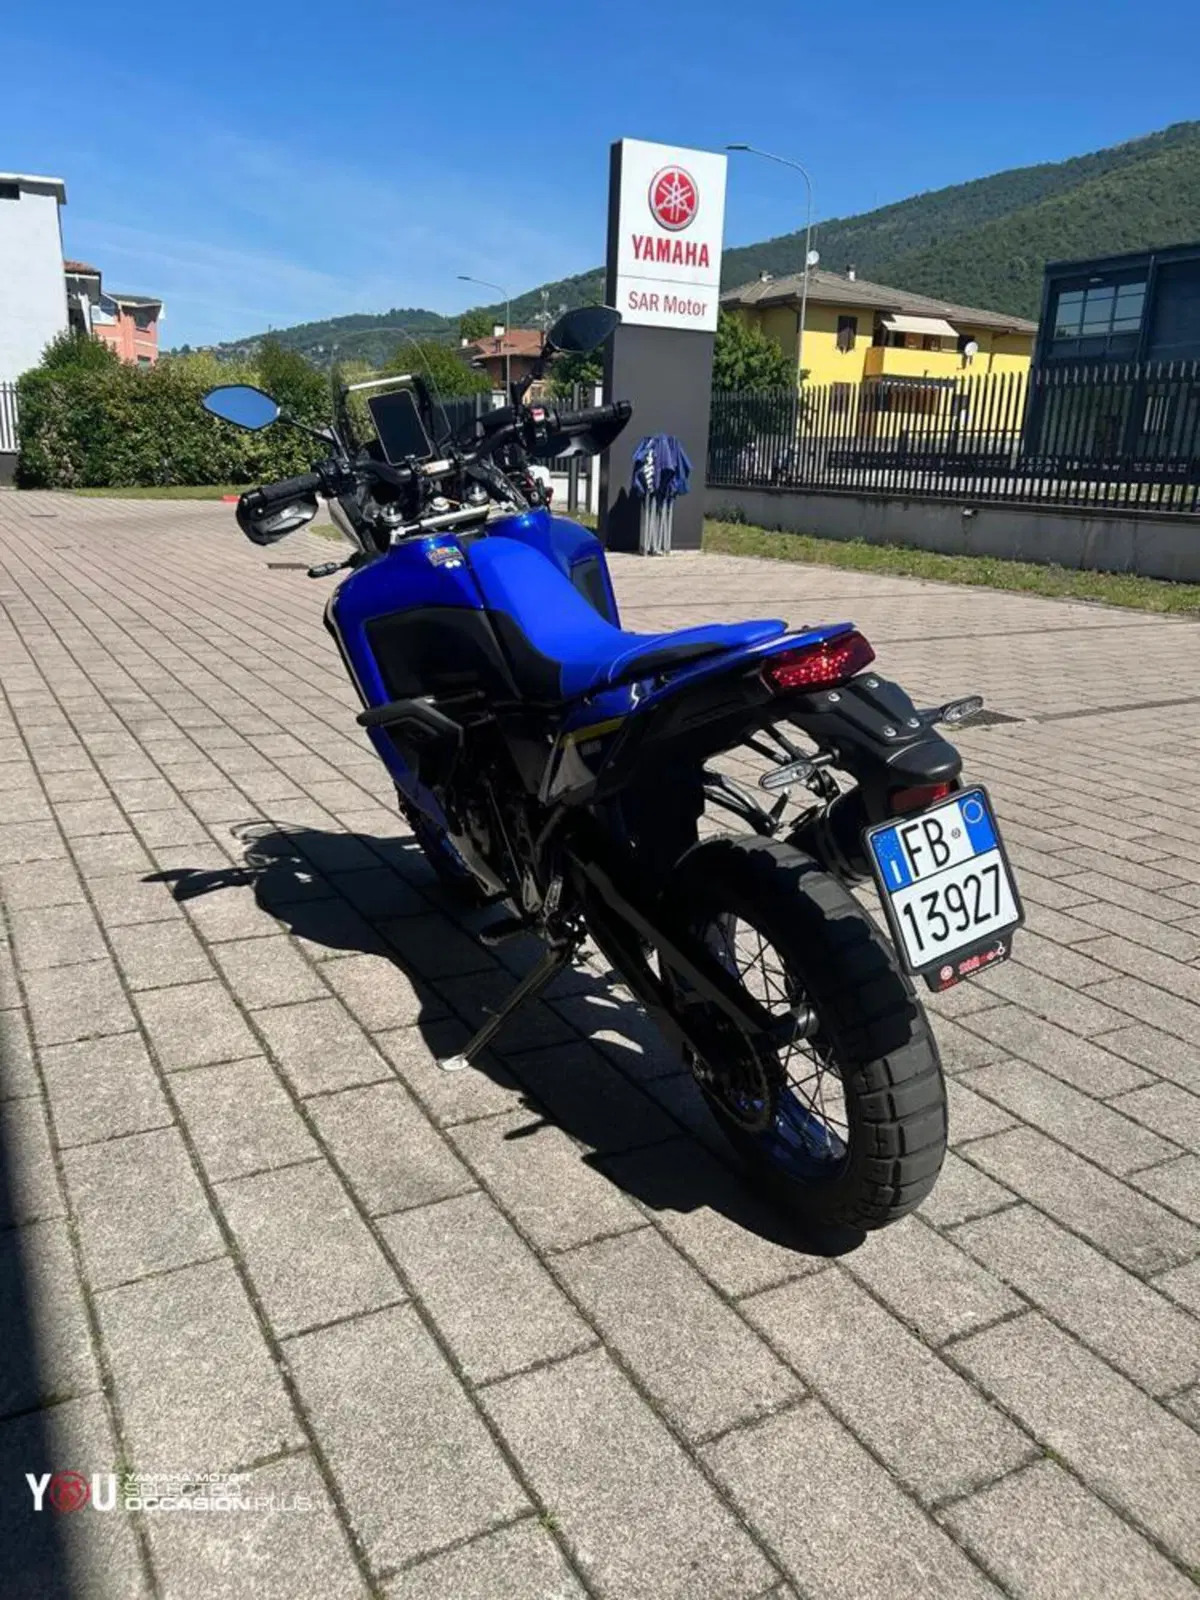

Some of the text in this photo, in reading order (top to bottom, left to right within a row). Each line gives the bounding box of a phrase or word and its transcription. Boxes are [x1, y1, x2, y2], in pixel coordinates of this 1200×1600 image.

[632, 234, 709, 268] YAMAHA
[628, 290, 708, 316] SAR Motor
[900, 817, 950, 877] FB
[903, 863, 1000, 951] 13927
